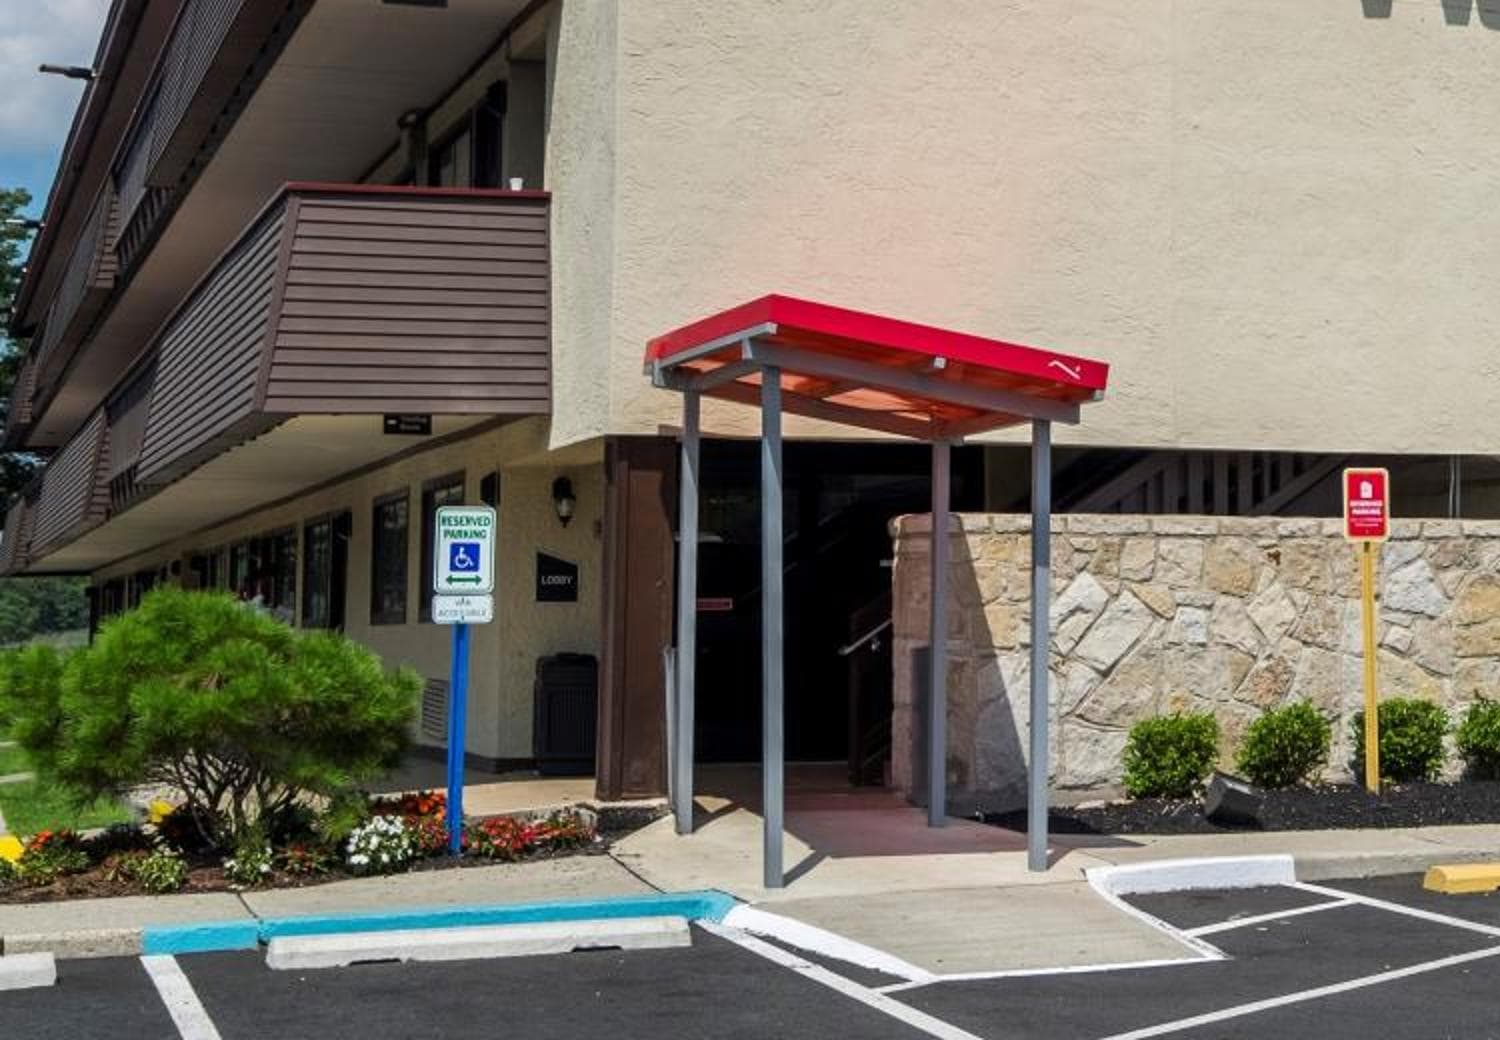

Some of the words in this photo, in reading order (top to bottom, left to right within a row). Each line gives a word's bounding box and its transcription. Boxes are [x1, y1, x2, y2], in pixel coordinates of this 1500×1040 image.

[441, 515, 490, 527] RESERVED
[443, 529, 487, 539] PARKING
[541, 575, 573, 585] LOBBY
